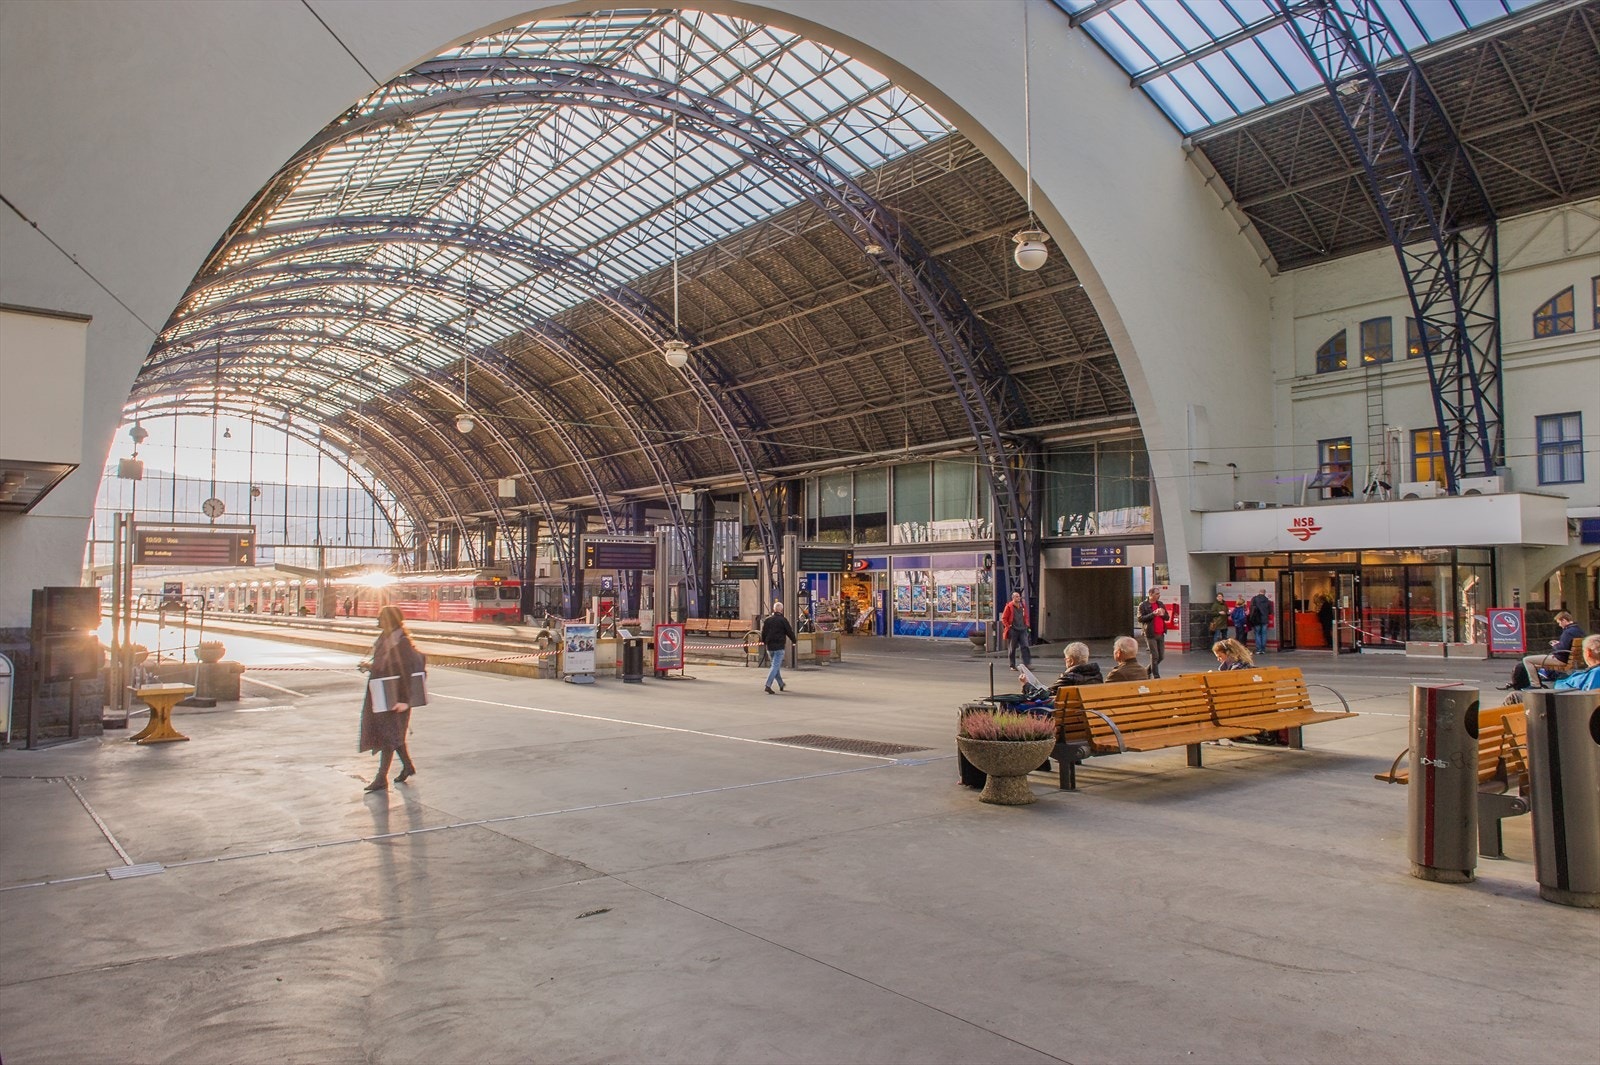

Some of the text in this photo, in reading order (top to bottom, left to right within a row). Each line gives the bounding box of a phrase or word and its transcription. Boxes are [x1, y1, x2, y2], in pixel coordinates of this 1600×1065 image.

[1293, 517, 1314, 527] NSB
[240, 554, 248, 563] 4
[587, 558, 593, 567] 3
[847, 563, 852, 571] 2
[604, 581, 610, 589] 3
